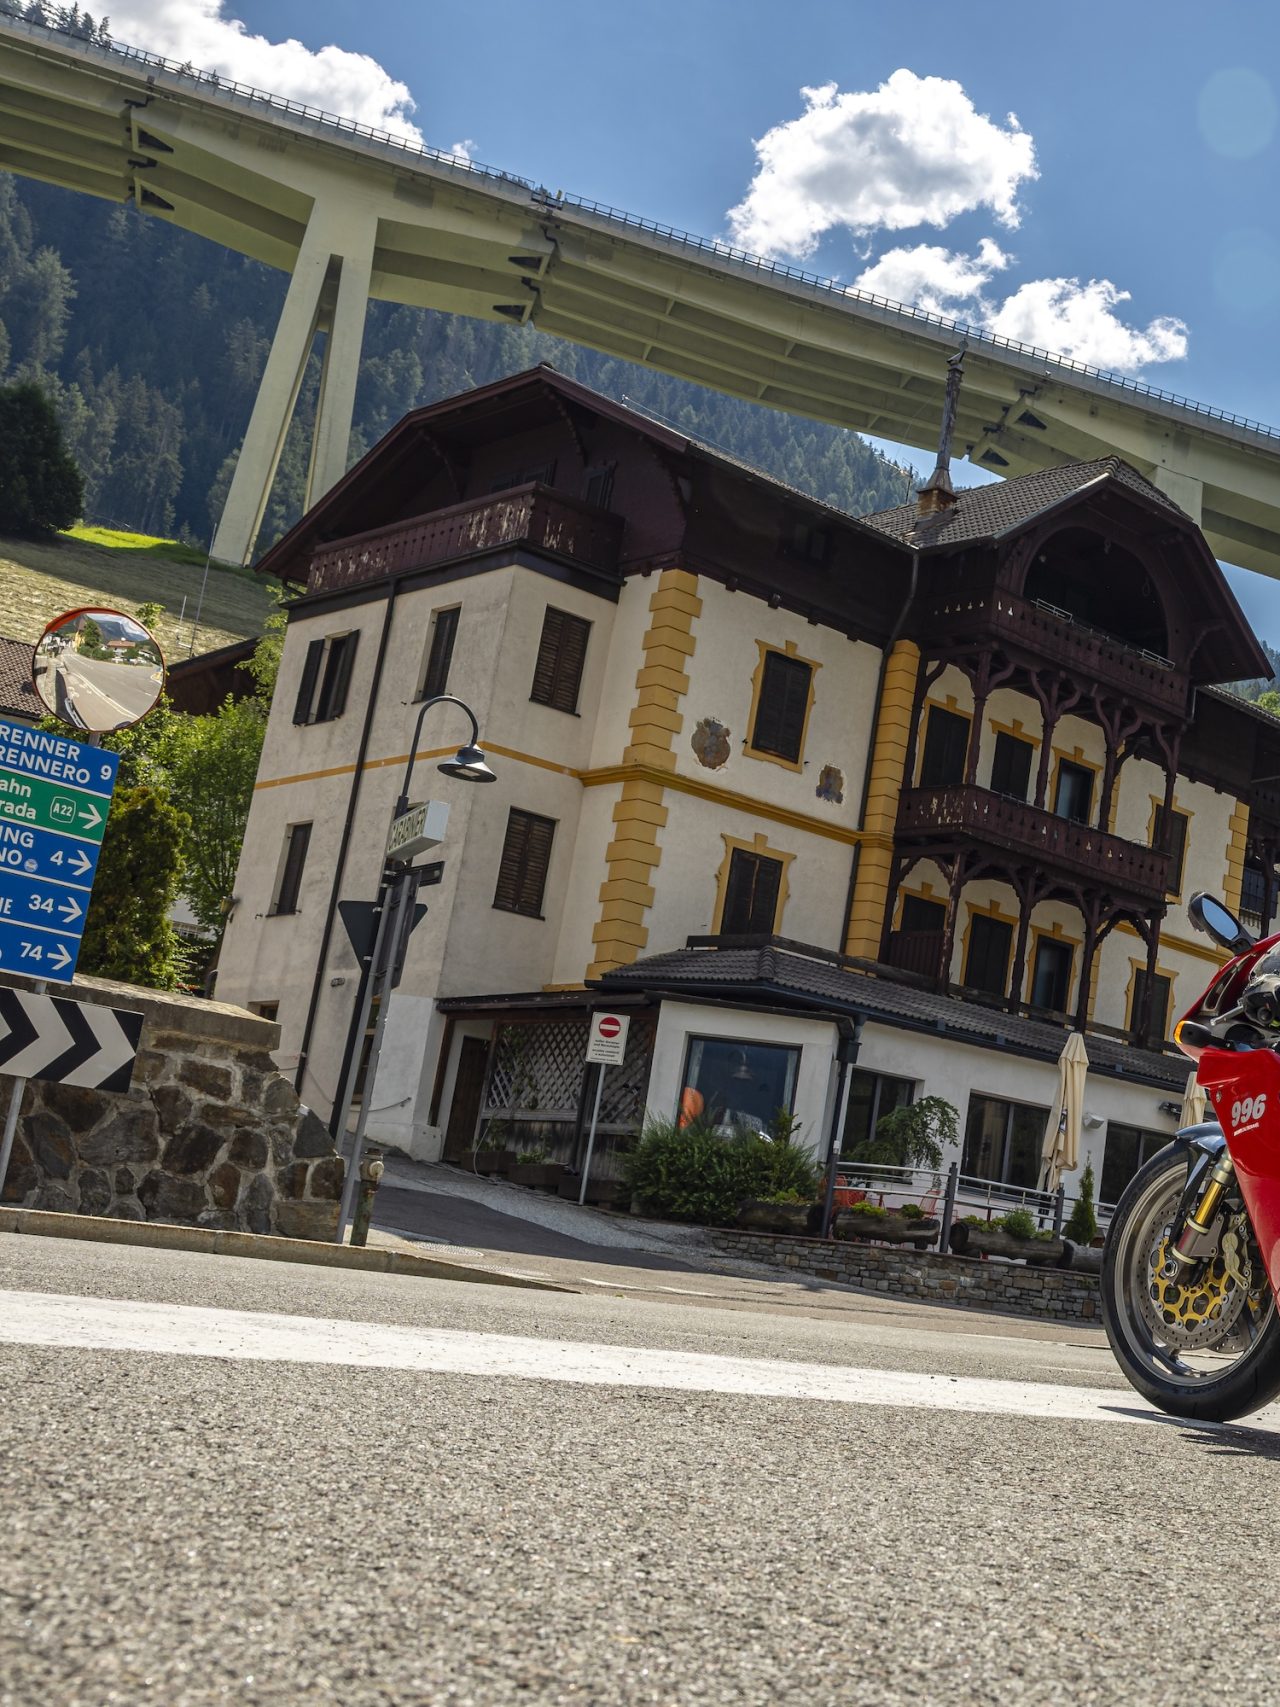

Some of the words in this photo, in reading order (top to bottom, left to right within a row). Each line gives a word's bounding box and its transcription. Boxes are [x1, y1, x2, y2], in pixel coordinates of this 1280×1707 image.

[100, 765, 112, 780] 9
[53, 802, 73, 817] A22
[50, 850, 64, 866] 4
[28, 894, 54, 914] 34
[20, 942, 43, 961] 74
[1231, 1093, 1267, 1128] 996
